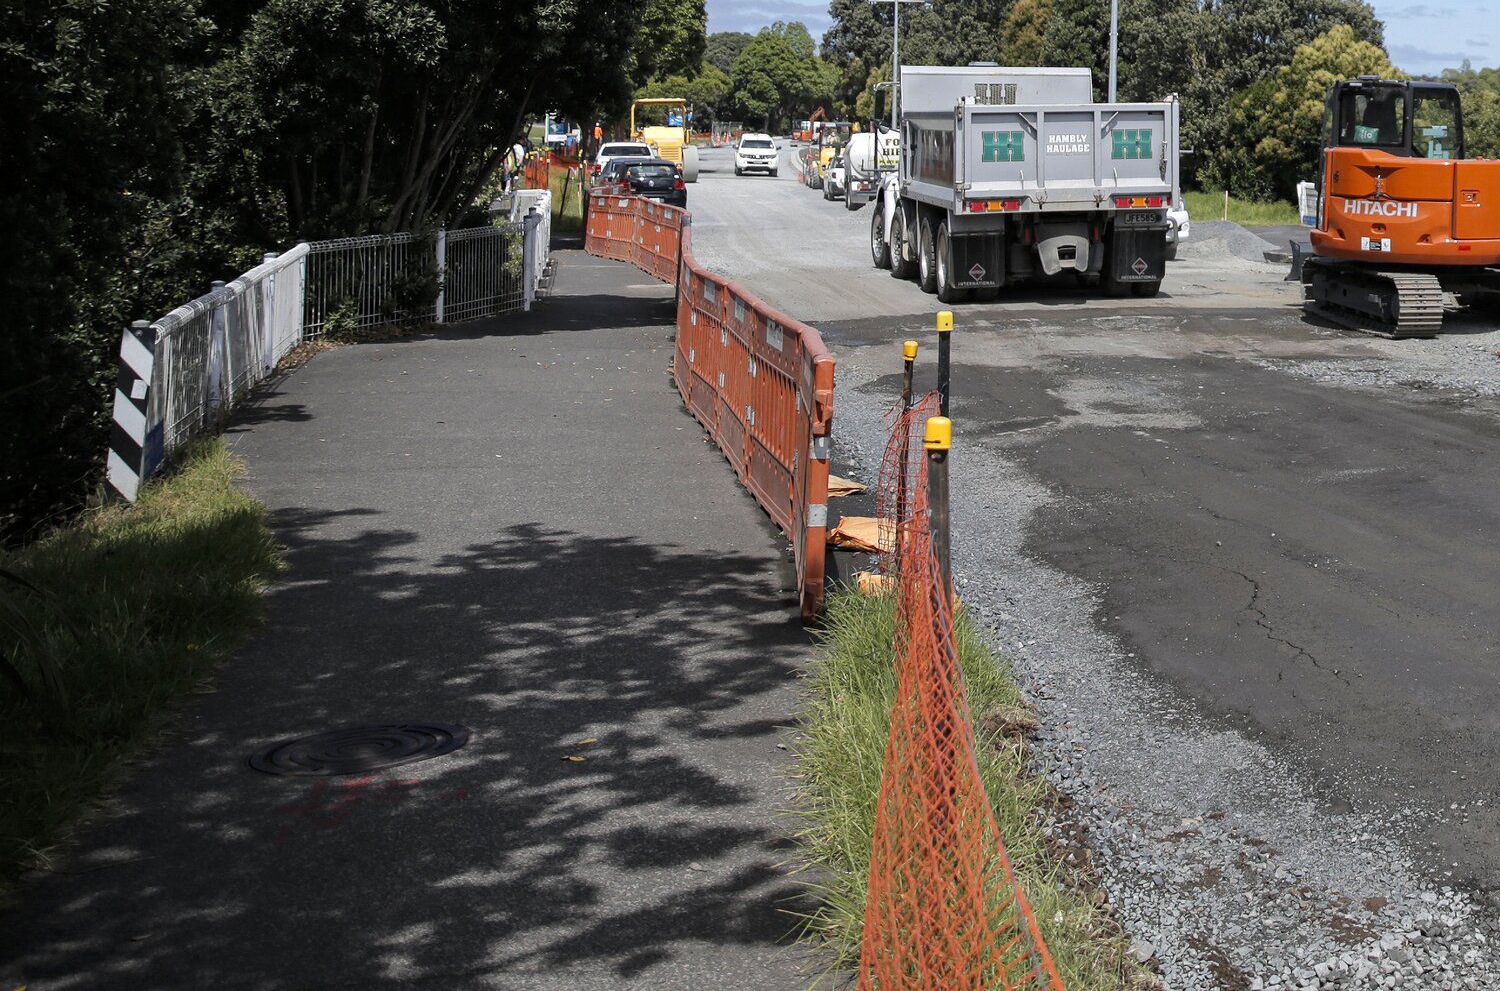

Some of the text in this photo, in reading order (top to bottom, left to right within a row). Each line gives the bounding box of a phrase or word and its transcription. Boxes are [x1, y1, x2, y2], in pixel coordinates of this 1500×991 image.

[1048, 134, 1088, 143] HAMBLY
[1046, 144, 1090, 153] HAULAGE
[1343, 199, 1418, 217] HITACHI
